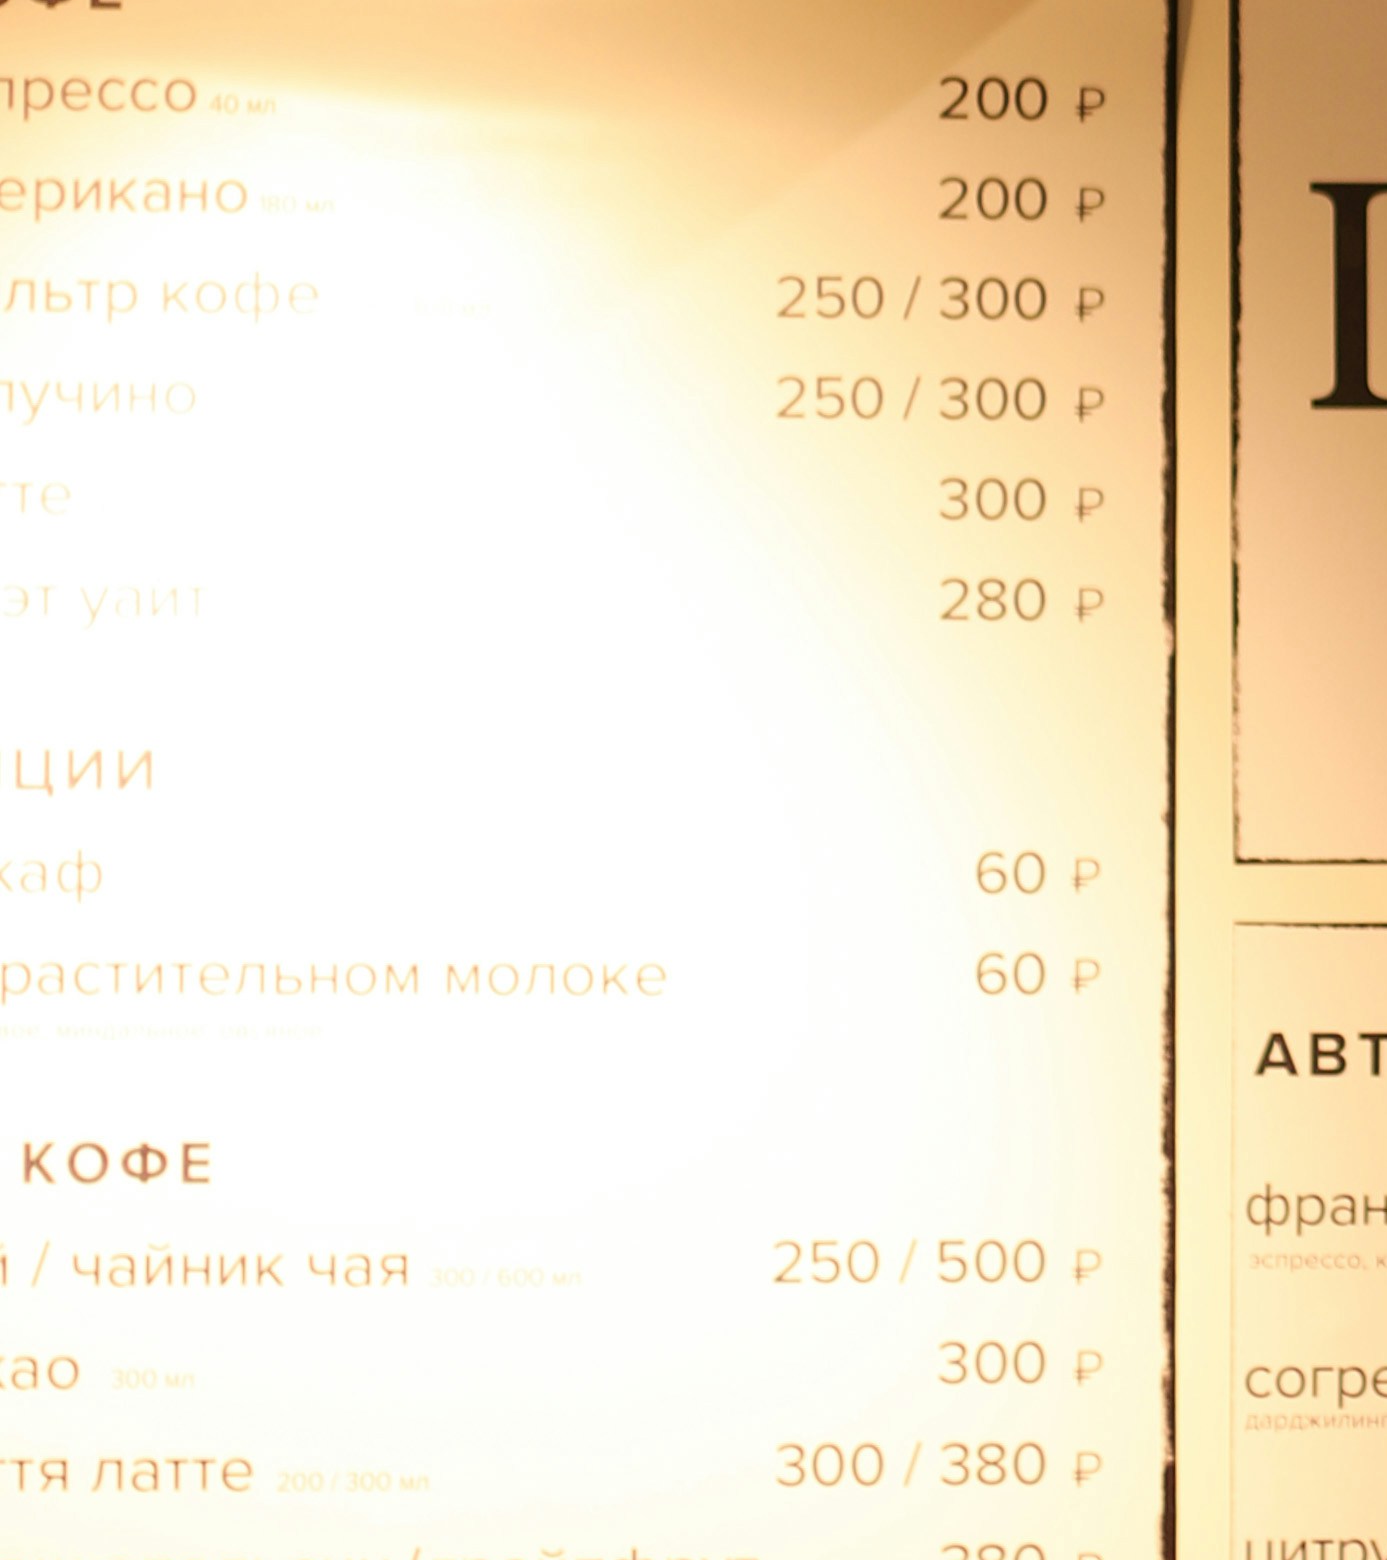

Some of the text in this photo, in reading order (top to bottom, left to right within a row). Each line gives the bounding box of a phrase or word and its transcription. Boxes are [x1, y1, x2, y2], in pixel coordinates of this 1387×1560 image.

[207, 93, 241, 117] 40
[245, 96, 277, 116] мл
[939, 75, 1048, 122] 200
[939, 175, 1048, 221] 200
[161, 271, 320, 324] кофе
[776, 274, 885, 320] 250
[940, 275, 1048, 321] 300
[775, 374, 884, 421] 250
[939, 376, 1048, 422] 300
[0, 480, 73, 515] те
[939, 476, 1047, 522] 300
[939, 576, 1047, 622] 280
[0, 748, 153, 797] ции
[975, 850, 1047, 895] 60
[0, 960, 420, 1007] растительном
[445, 962, 668, 997] молоке
[975, 950, 1047, 996] 60
[23, 1141, 211, 1185] КОФЕ
[72, 1244, 284, 1288] чайник
[307, 1252, 409, 1288] чая
[772, 1238, 881, 1285] 250
[937, 1238, 1047, 1284] 500
[0, 1355, 81, 1392] ао
[111, 1367, 159, 1391] 300
[163, 1372, 196, 1389] мл
[938, 1339, 1047, 1386] 300
[91, 1456, 254, 1493] латте
[275, 1470, 325, 1495] 200
[345, 1470, 394, 1493] 300
[775, 1441, 885, 1488] 300
[940, 1440, 1047, 1487] 380
